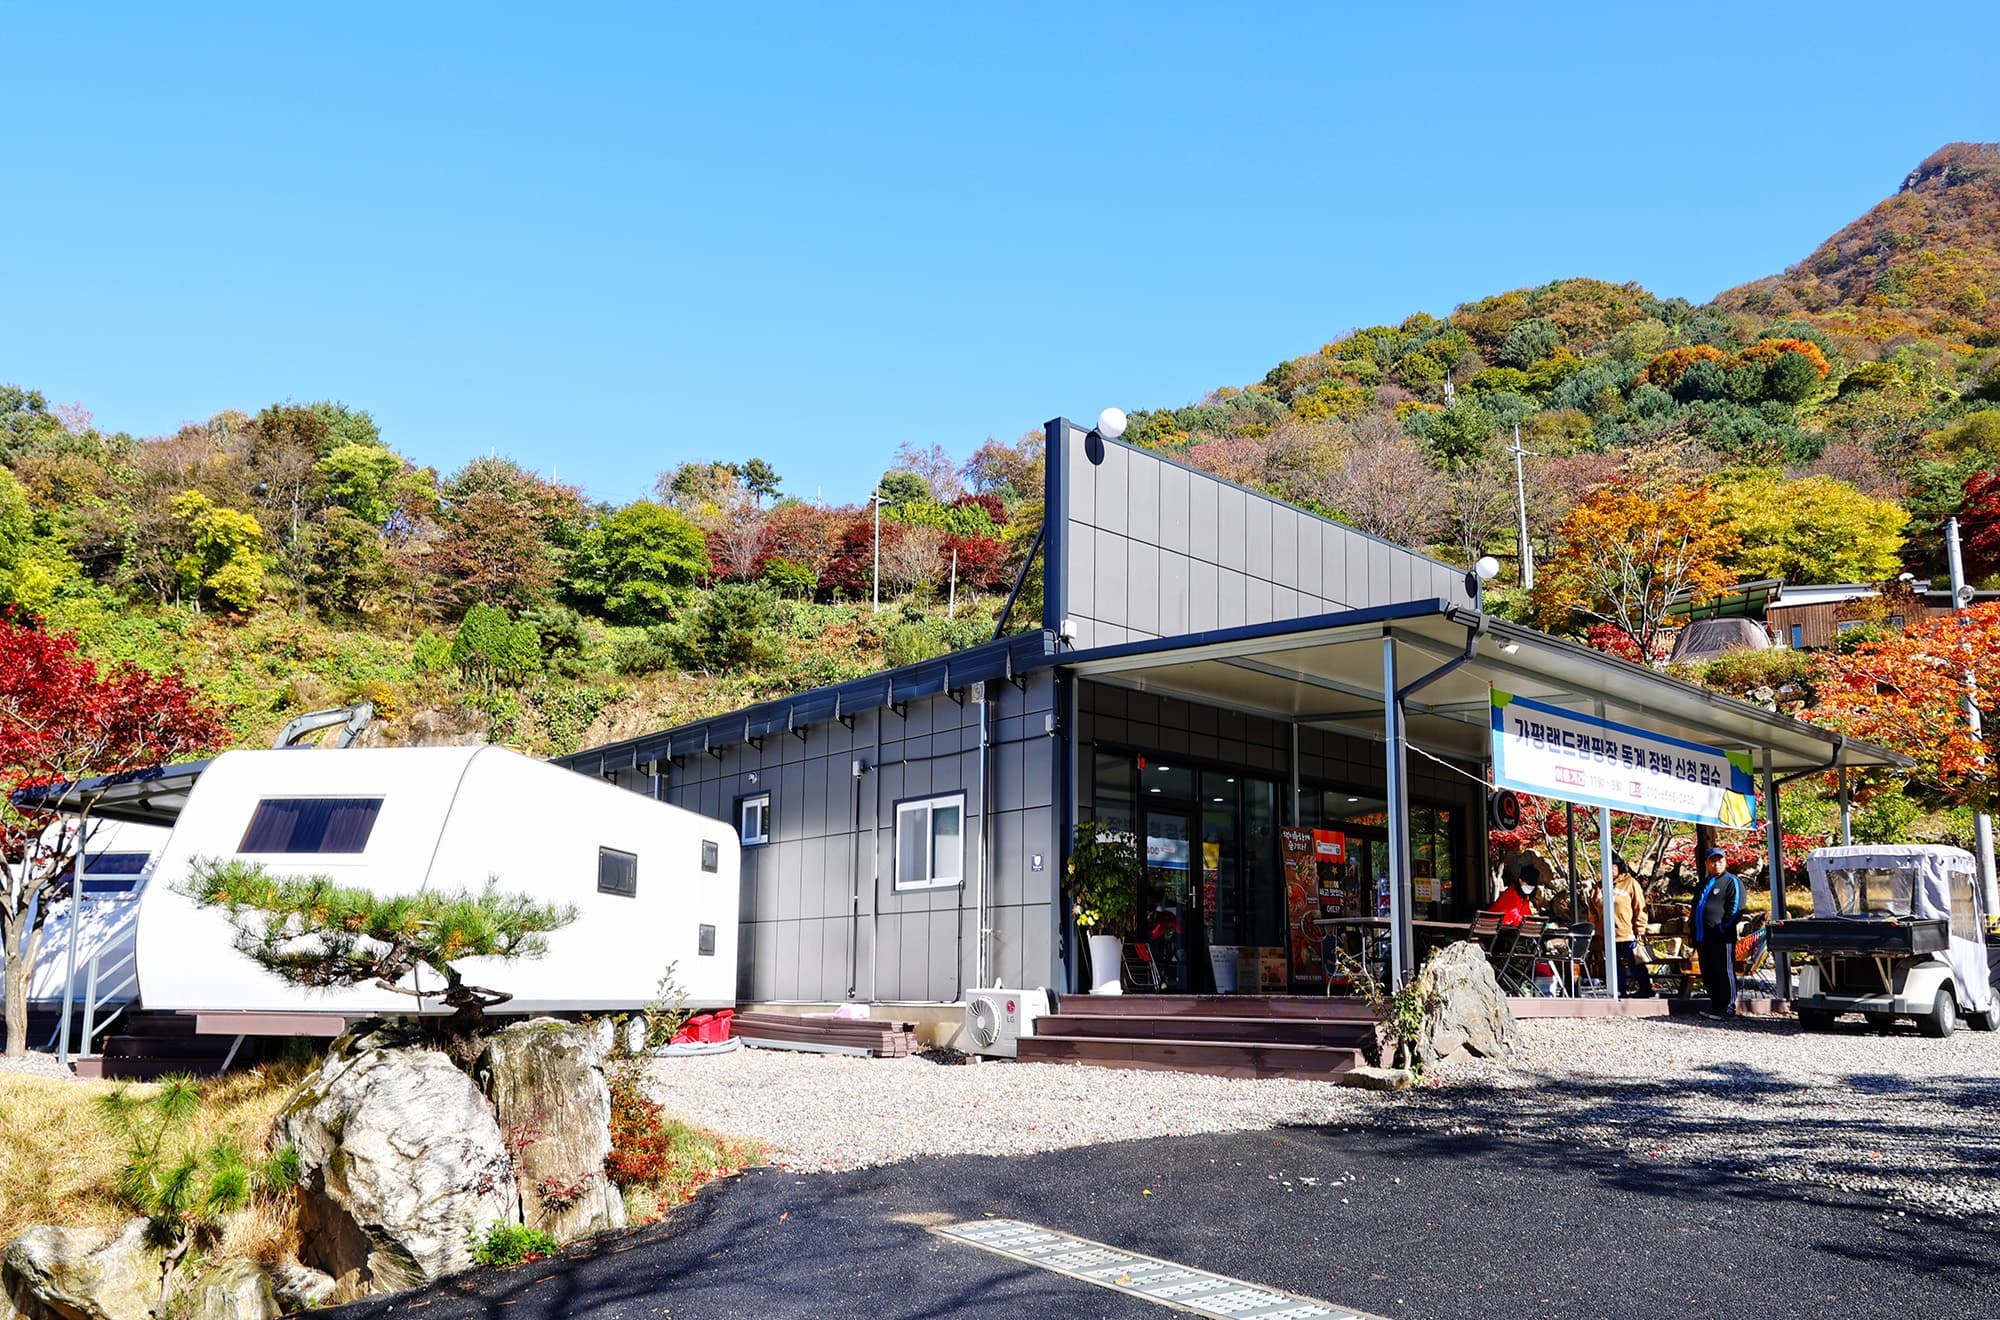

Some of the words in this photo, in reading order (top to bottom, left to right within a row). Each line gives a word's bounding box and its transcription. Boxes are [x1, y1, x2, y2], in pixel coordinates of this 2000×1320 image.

[1514, 718, 1618, 766] 가평랜드캠핑장
[1622, 744, 1646, 771] 동계
[1649, 751, 1672, 777] 장박
[1676, 757, 1697, 783] 신청
[1700, 763, 1720, 787] 접수
